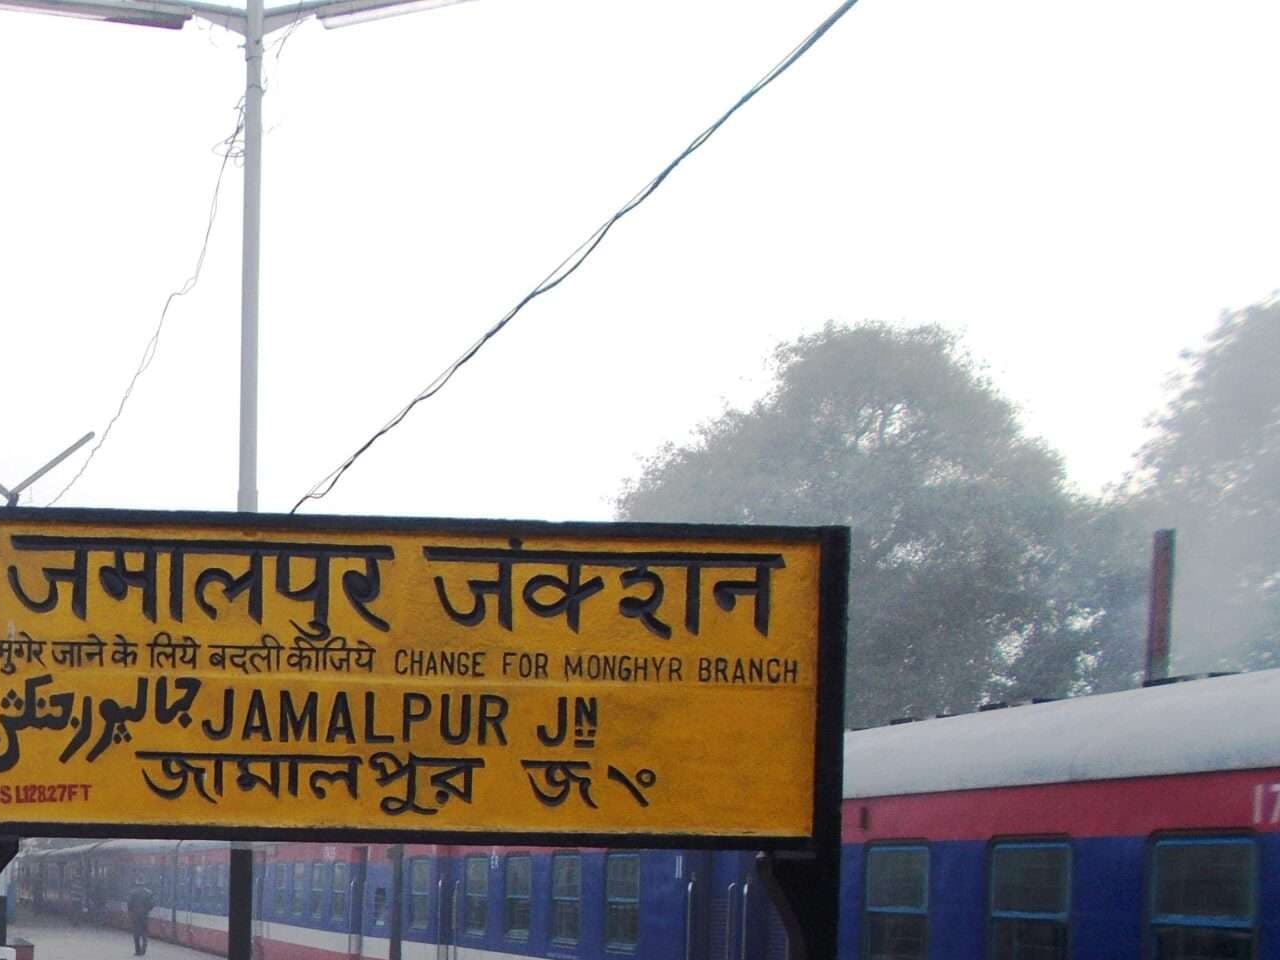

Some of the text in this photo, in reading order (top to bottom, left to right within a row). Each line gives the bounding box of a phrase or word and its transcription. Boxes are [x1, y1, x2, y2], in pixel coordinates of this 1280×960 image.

[8, 535, 395, 640] जमालपुर
[51, 634, 108, 667] जाने
[111, 634, 138, 667] के
[146, 632, 200, 669] लिये
[208, 634, 285, 674] बदली
[394, 649, 798, 684] CHANGE FOR MONGHYR BRANCH
[202, 688, 509, 746] JAMALPUR
[134, 749, 486, 816] জামালপুর
